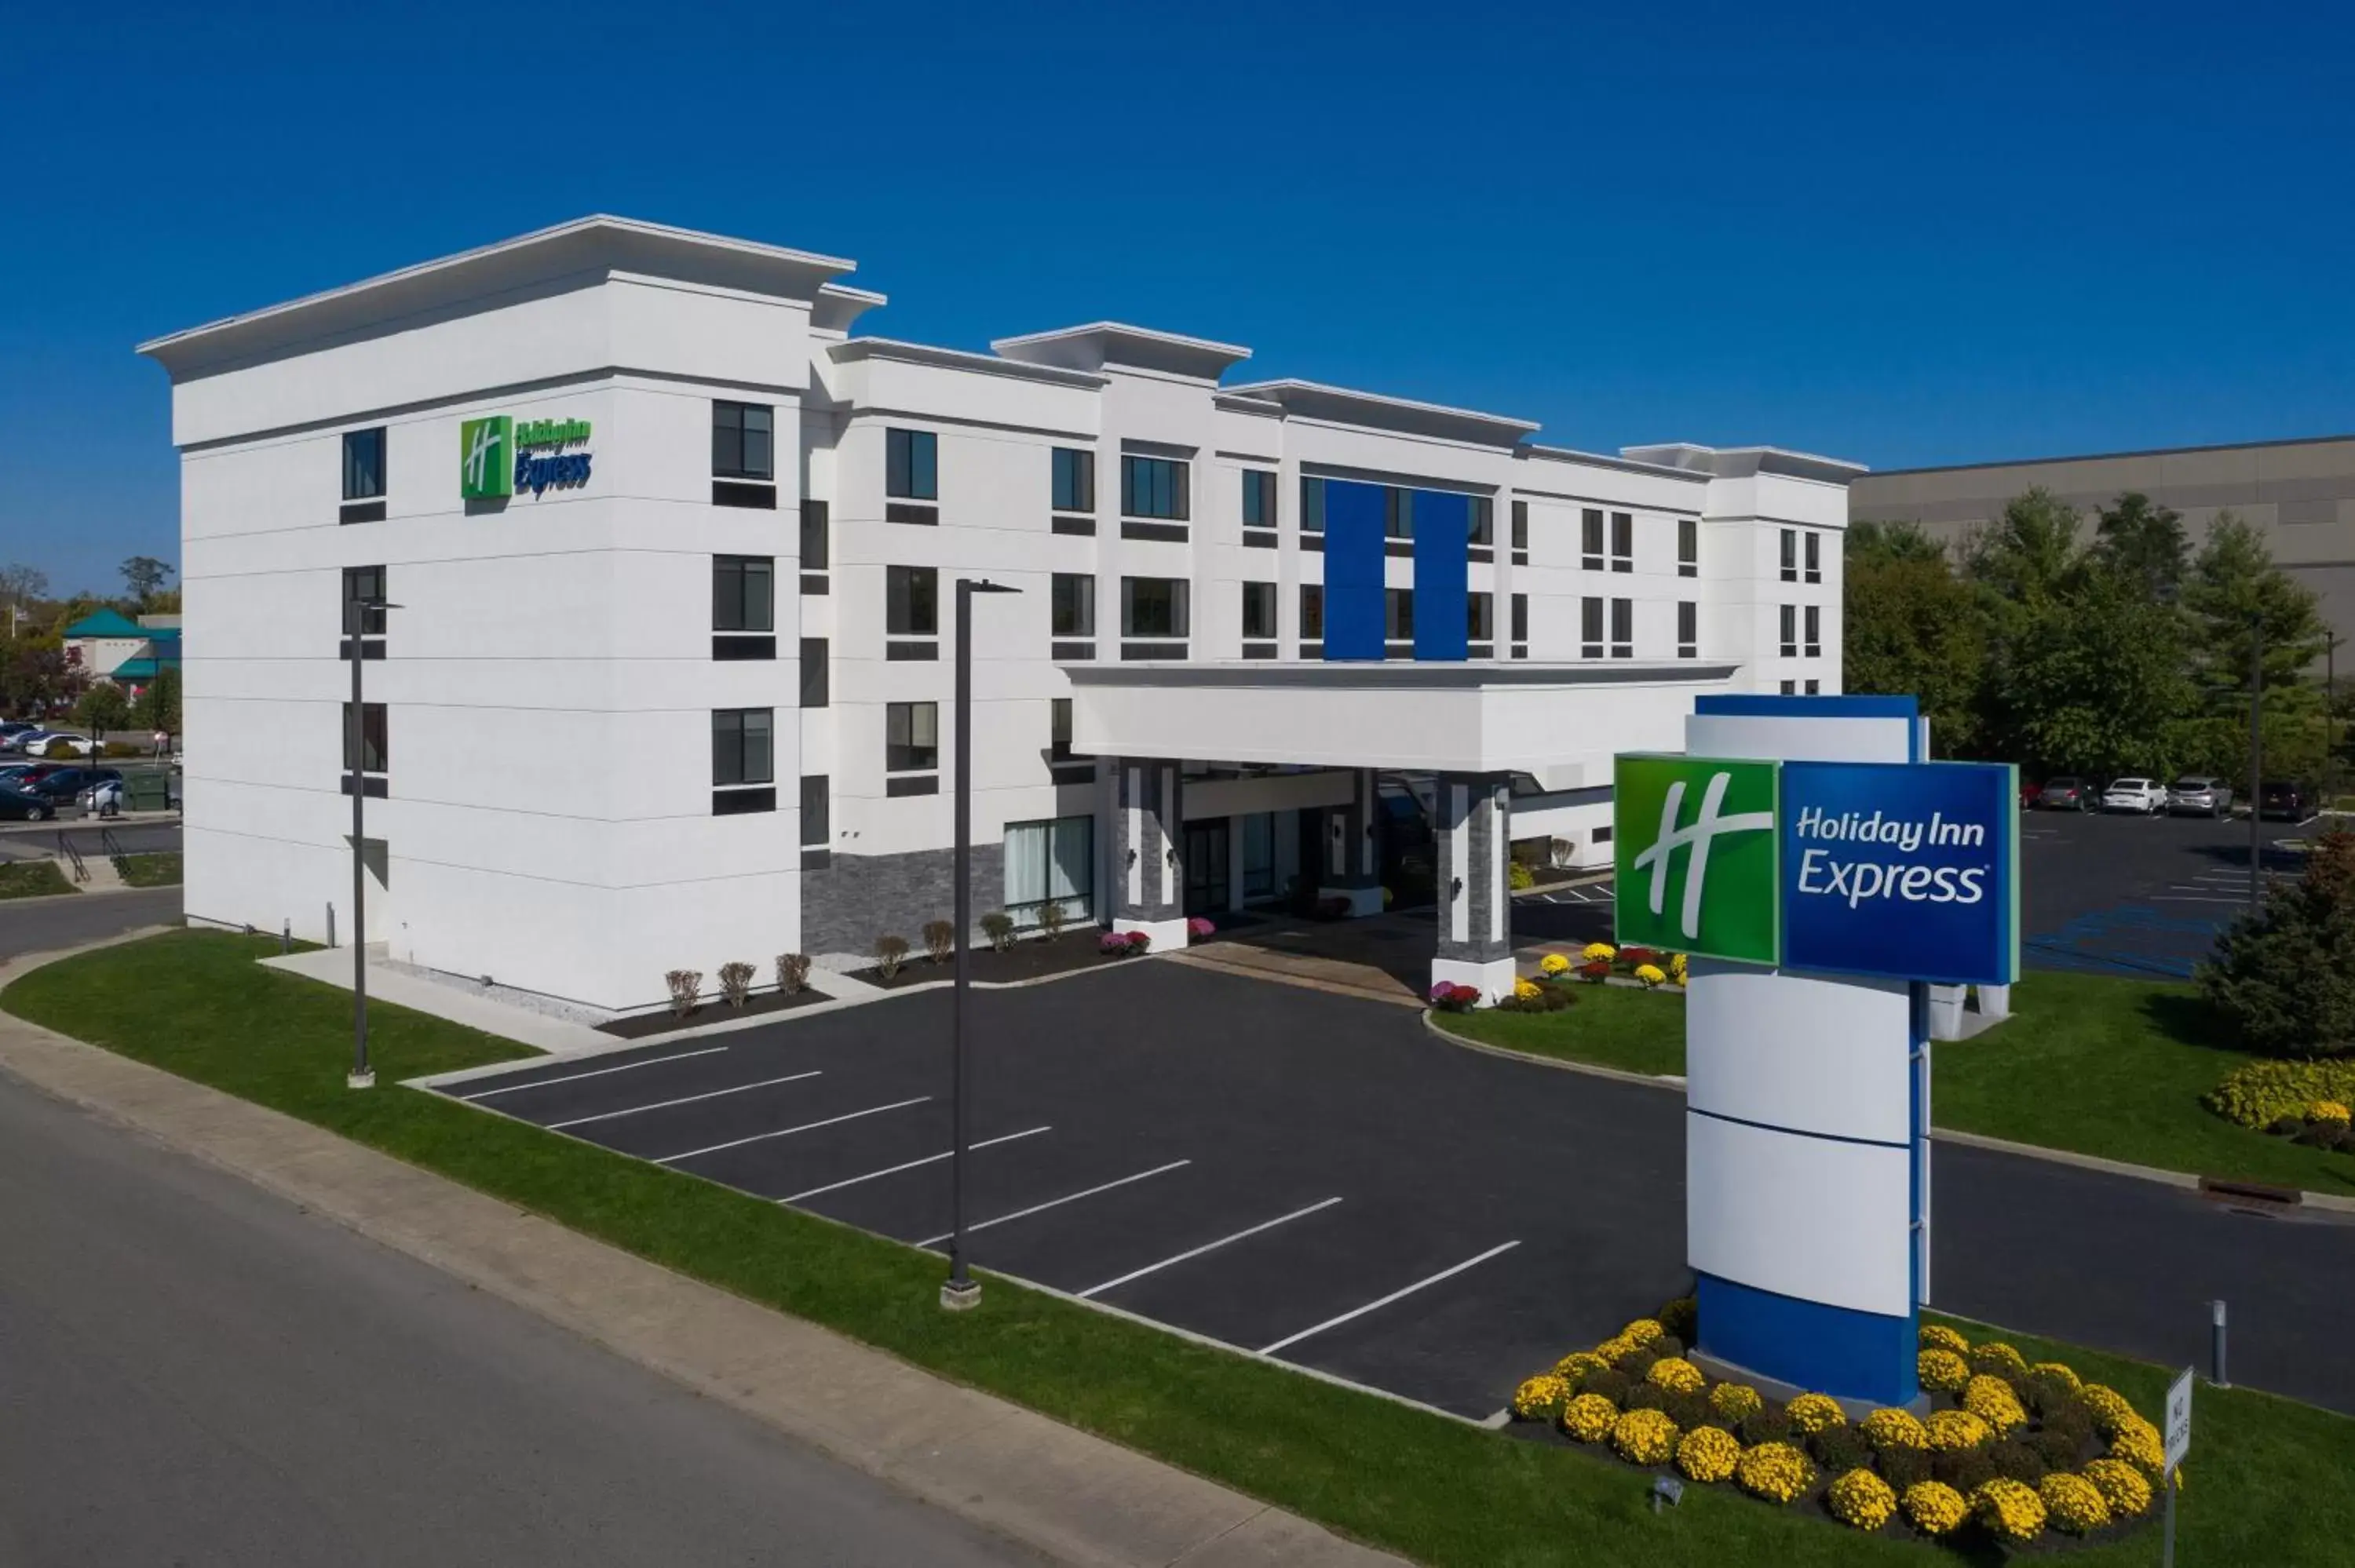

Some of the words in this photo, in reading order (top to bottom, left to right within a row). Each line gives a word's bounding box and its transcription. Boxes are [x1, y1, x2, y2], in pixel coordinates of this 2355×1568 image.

[1797, 806, 1923, 851] Holiday
[1928, 811, 1984, 847] Inn
[1798, 848, 1985, 910] Express
